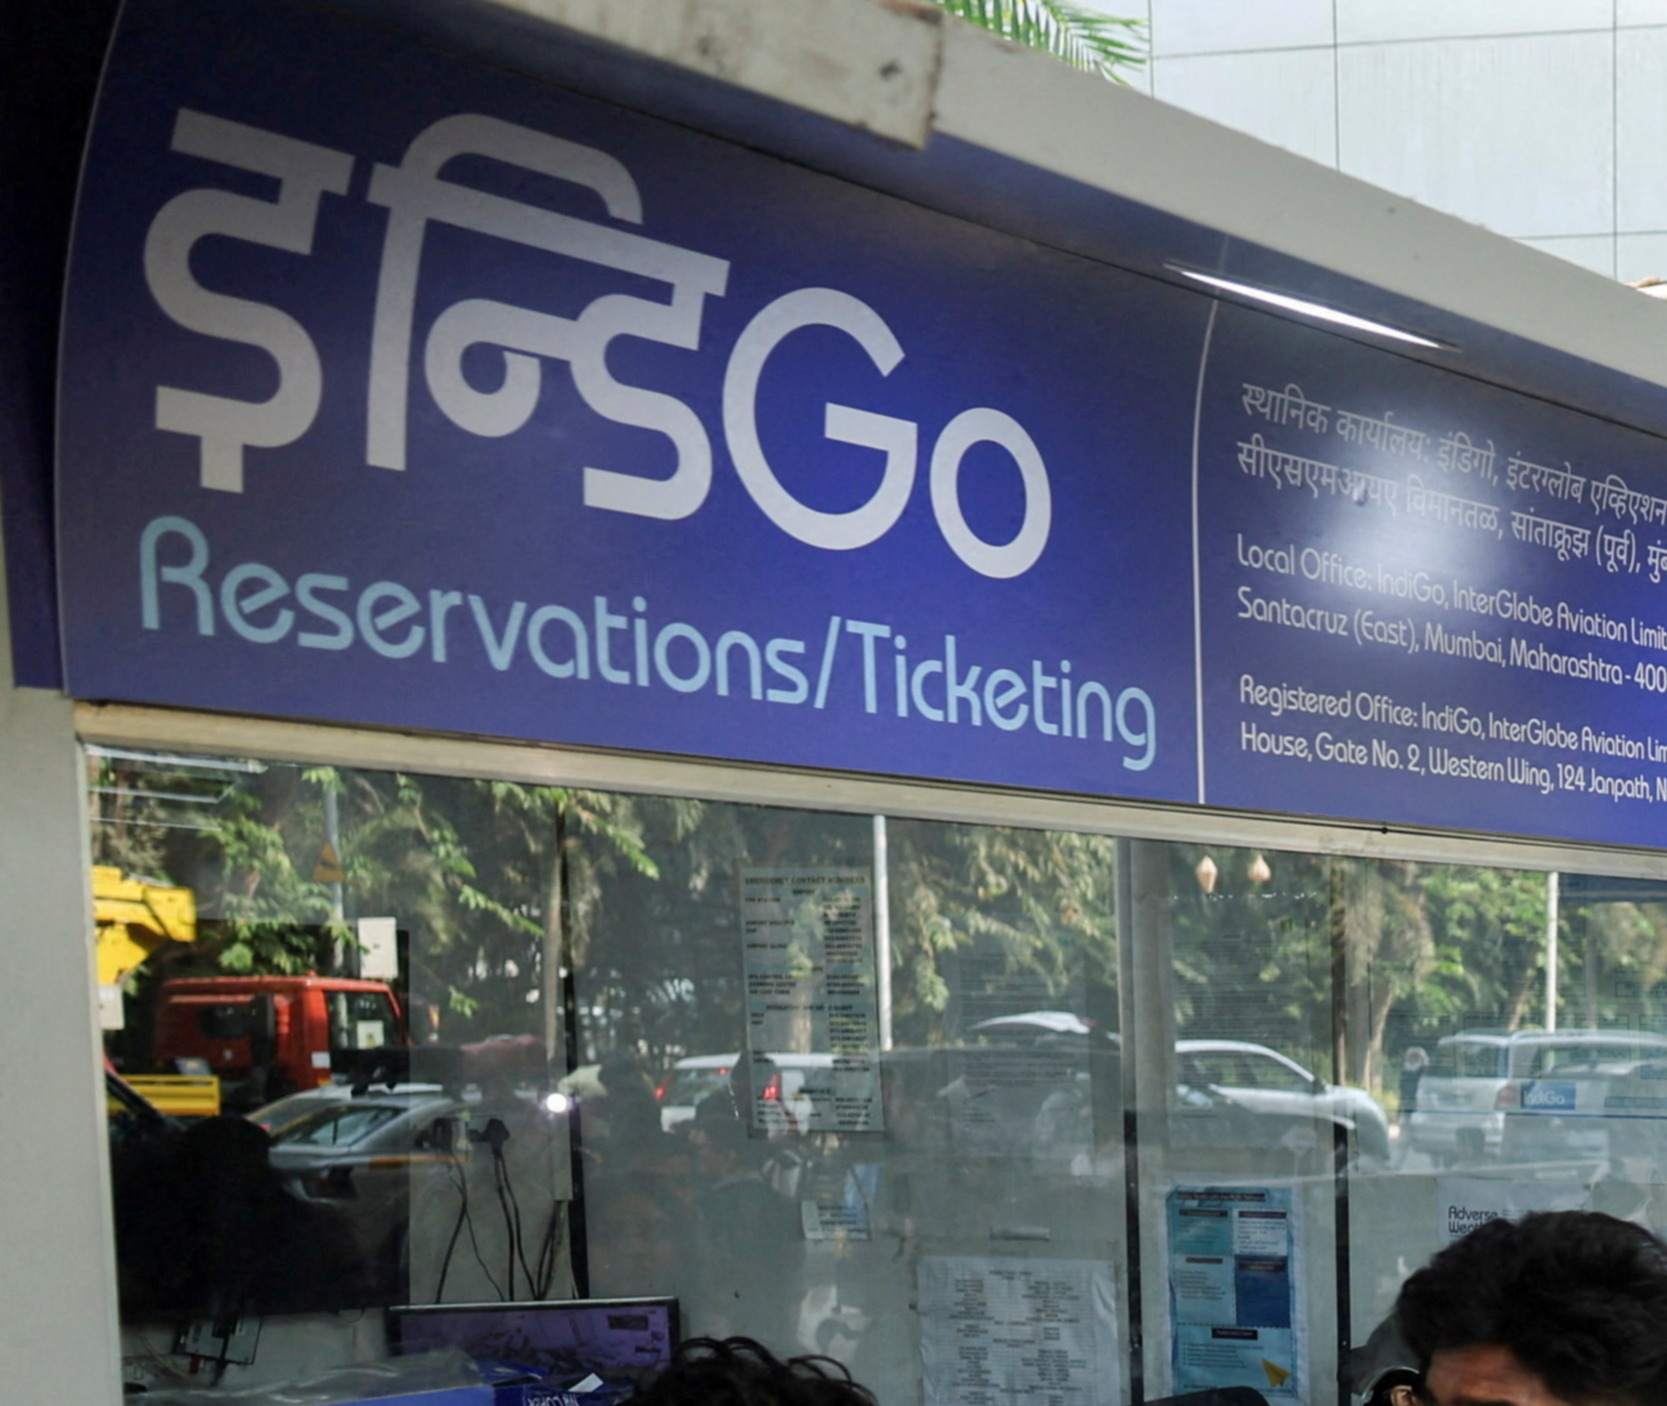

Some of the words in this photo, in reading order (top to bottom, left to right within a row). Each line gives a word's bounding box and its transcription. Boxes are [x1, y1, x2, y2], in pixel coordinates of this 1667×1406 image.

[1242, 383, 1331, 433] स्थानिक
[1336, 412, 1431, 464] कार्यालय:
[1437, 431, 1499, 487] इंडिगो,
[1506, 450, 1586, 504] इंटरग्लोब
[1406, 474, 1504, 541] विमानतळ,
[1595, 525, 1641, 574] (पूर्व),
[1237, 533, 1295, 576] Local
[1300, 547, 1373, 591] Office:
[1377, 563, 1450, 610] IndiGo,
[1453, 580, 1553, 628] InterGlobe
[1557, 602, 1627, 643] Aviation
[1237, 586, 1349, 636] Santacruz
[1353, 608, 1420, 654] (East),
[1424, 621, 1506, 668] Mumbai,
[1510, 637, 1623, 685] Maharashtra
[138, 515, 1157, 772] Reservations/Ticketing
[1240, 673, 1352, 717] Registered
[1355, 692, 1419, 728] Office:
[1422, 702, 1486, 740] IndiGo,
[1489, 712, 1578, 750] InterGlobe
[1582, 726, 1644, 760] Aviation
[1240, 721, 1313, 762] House,
[1315, 732, 1368, 764] Gate
[1372, 739, 1403, 770] No.
[1407, 744, 1426, 776] 2,
[1428, 746, 1505, 781] Western
[1508, 756, 1554, 795] Wing,
[1557, 763, 1585, 791] 124
[1588, 768, 1653, 803] Janpath,
[1448, 1205, 1498, 1220] Adverse
